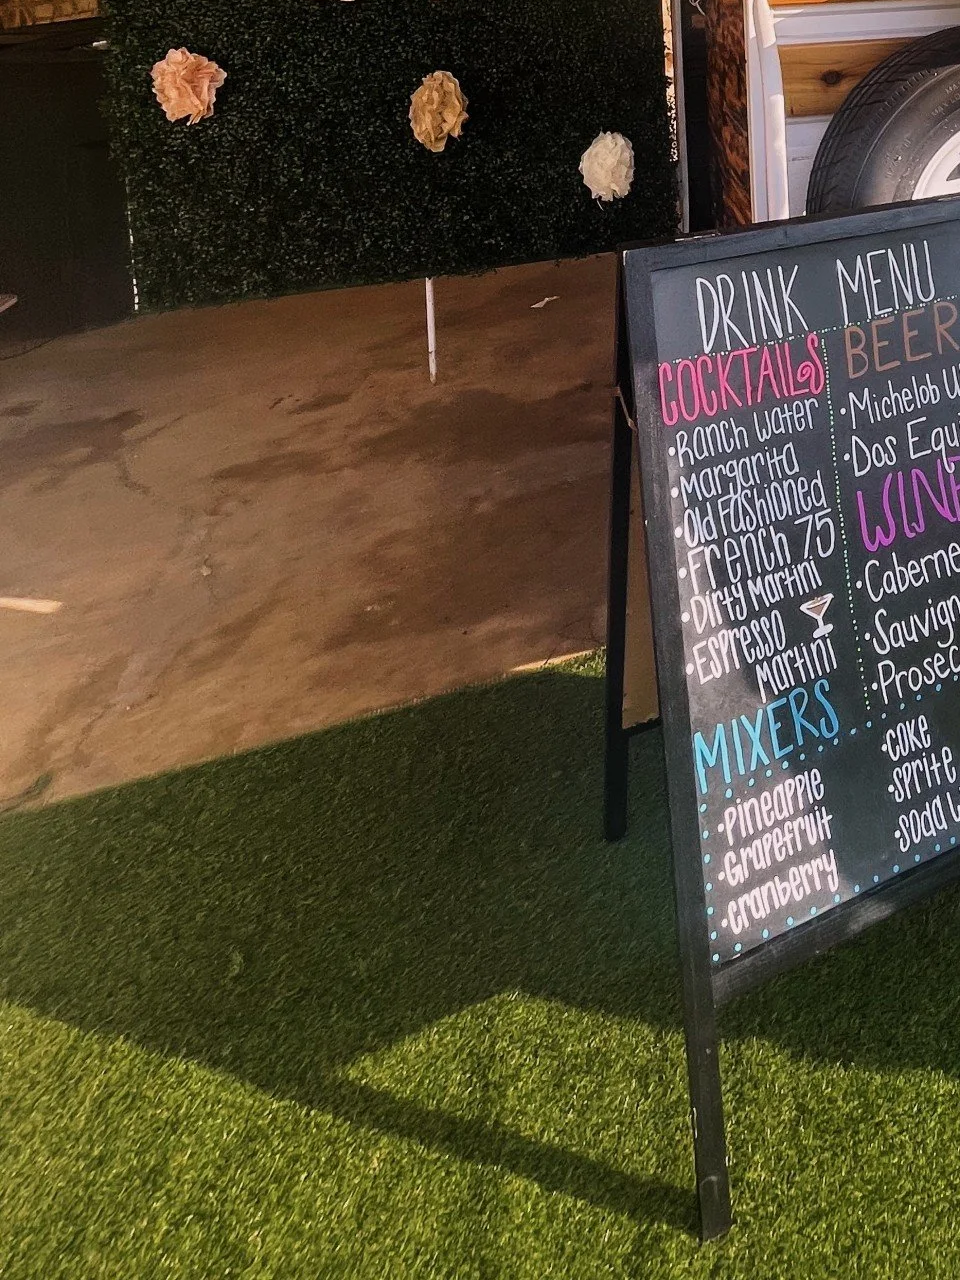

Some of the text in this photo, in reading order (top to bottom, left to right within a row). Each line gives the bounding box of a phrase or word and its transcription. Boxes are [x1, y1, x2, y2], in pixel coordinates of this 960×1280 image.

[696, 240, 936, 354] DRINK MENU
[658, 332, 826, 426] COCKTAILS
[844, 301, 960, 379] BEER
[849, 373, 941, 429] Michelob
[676, 417, 749, 467] Ranch
[679, 441, 800, 508] Margarita
[852, 435, 897, 477] Dos
[684, 470, 828, 548] Old Fashioned
[687, 508, 836, 595] French 75
[690, 555, 822, 635] Dirty Martini
[693, 609, 786, 685] Espresso
[755, 633, 838, 704] Martini
[694, 679, 839, 794] MIXERS
[724, 768, 825, 846] Pineapple
[724, 805, 833, 887] Grapefruit
